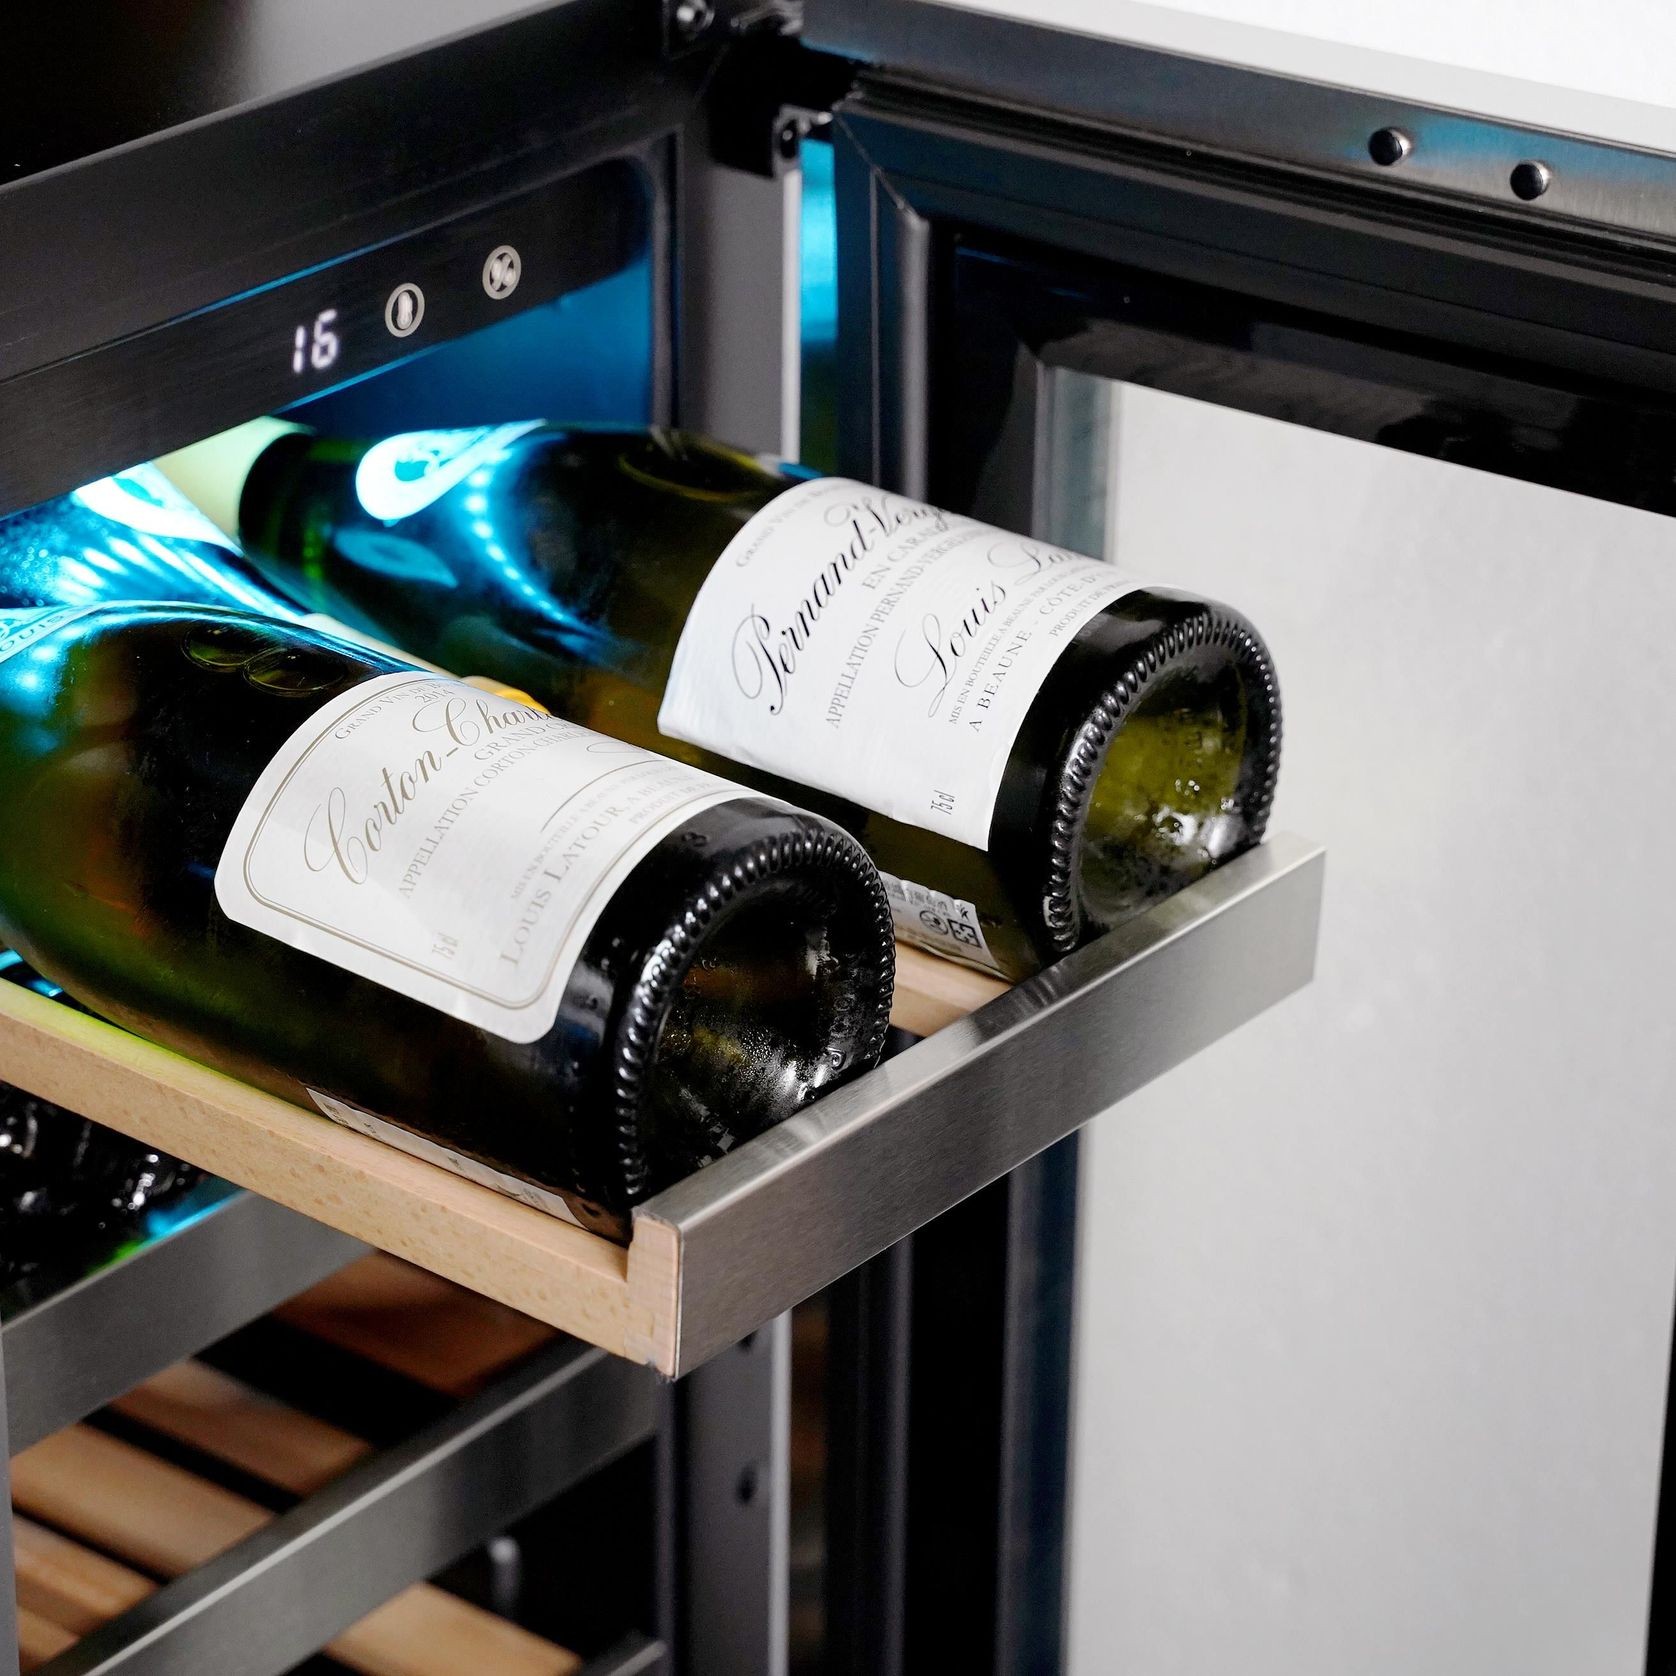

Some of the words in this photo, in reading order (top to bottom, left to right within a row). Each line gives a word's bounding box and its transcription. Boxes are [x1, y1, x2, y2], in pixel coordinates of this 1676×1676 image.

[293, 308, 339, 373] 16
[861, 564, 892, 590] EN
[895, 580, 1006, 718] Louis
[1049, 597, 1091, 637] PRODUIT
[414, 688, 456, 704] 2014
[825, 623, 880, 729] APPELLATION
[948, 704, 963, 725] MIS
[957, 687, 971, 705] EN
[964, 633, 1001, 688] BOUTEILLE
[968, 719, 983, 732] A
[976, 629, 1033, 709] BEAUNE
[474, 725, 546, 761] GRAND
[398, 786, 480, 899] APPELLATION
[931, 799, 953, 815] 75
[500, 888, 552, 966] LOUIS
